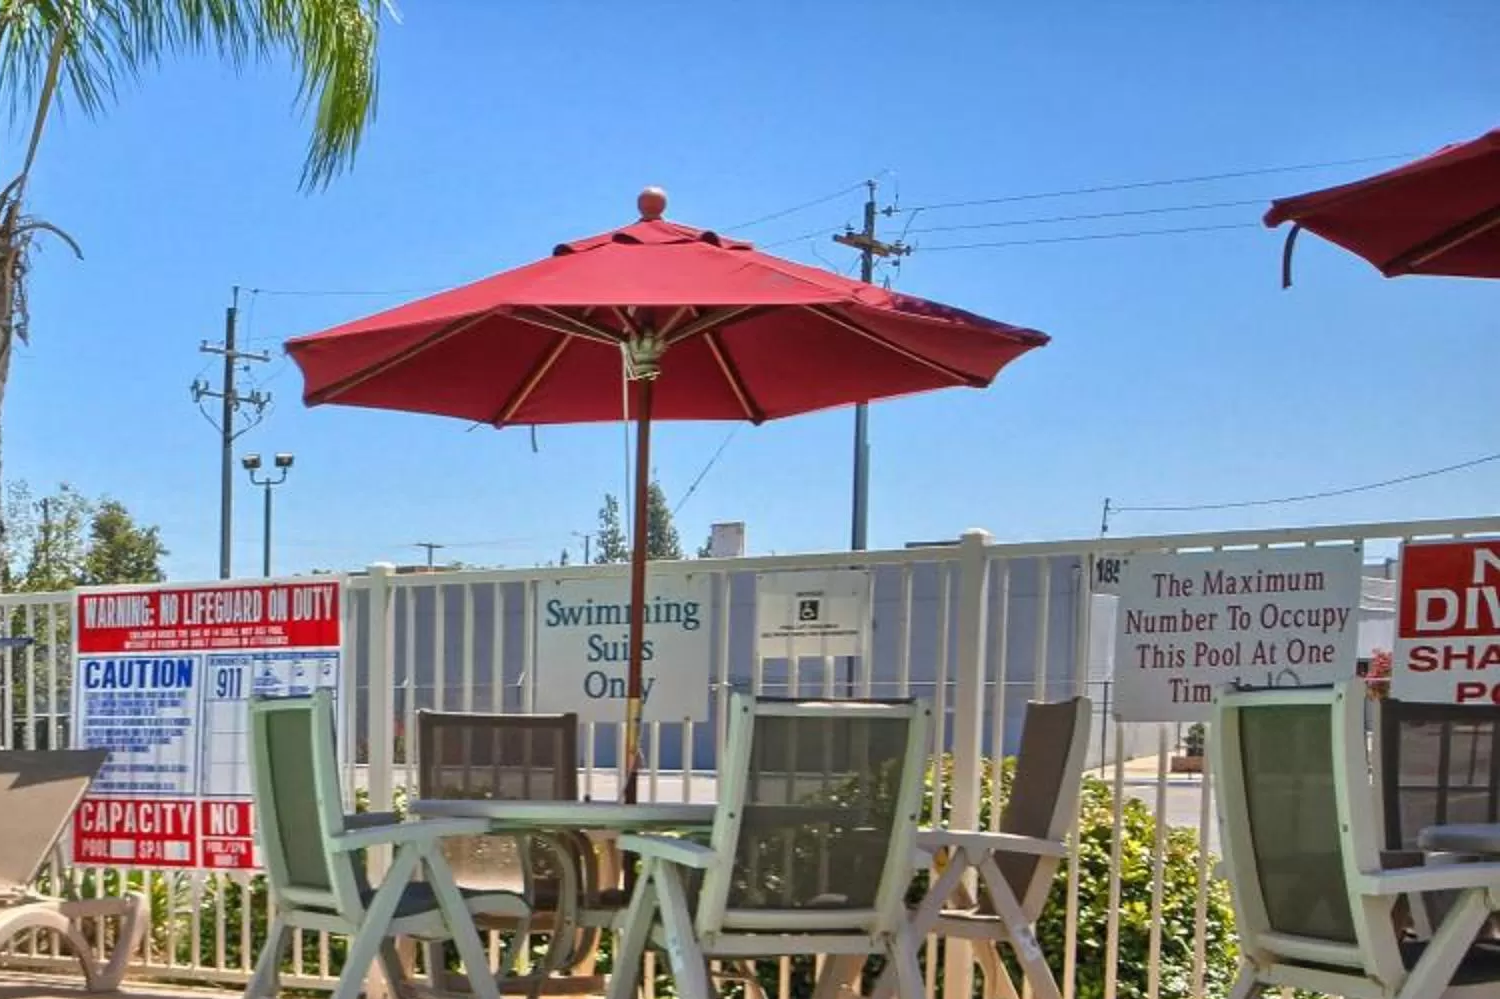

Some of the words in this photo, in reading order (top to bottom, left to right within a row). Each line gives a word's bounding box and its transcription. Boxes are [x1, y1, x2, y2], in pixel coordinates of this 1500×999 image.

[1152, 571, 1193, 598] The
[1203, 569, 1325, 596] Maximum
[84, 595, 155, 628] WARNING:
[160, 592, 179, 626] NO
[183, 588, 262, 625] LIFEGUARD
[268, 587, 288, 622] ON
[293, 584, 333, 621] DUTY
[1124, 607, 1218, 634] Number
[1227, 605, 1252, 631] To
[1260, 603, 1350, 634] Occupy
[587, 633, 653, 662] Suis
[1136, 644, 1186, 669] This
[1193, 641, 1241, 667] Pool
[1251, 640, 1277, 665] At
[1286, 638, 1336, 665] One
[85, 659, 194, 689] CAUTION
[216, 668, 242, 697] 911
[584, 670, 656, 704] Ony
[1168, 678, 1213, 704] Tim
[80, 801, 193, 835] CAPACITY
[210, 803, 239, 835] NO
